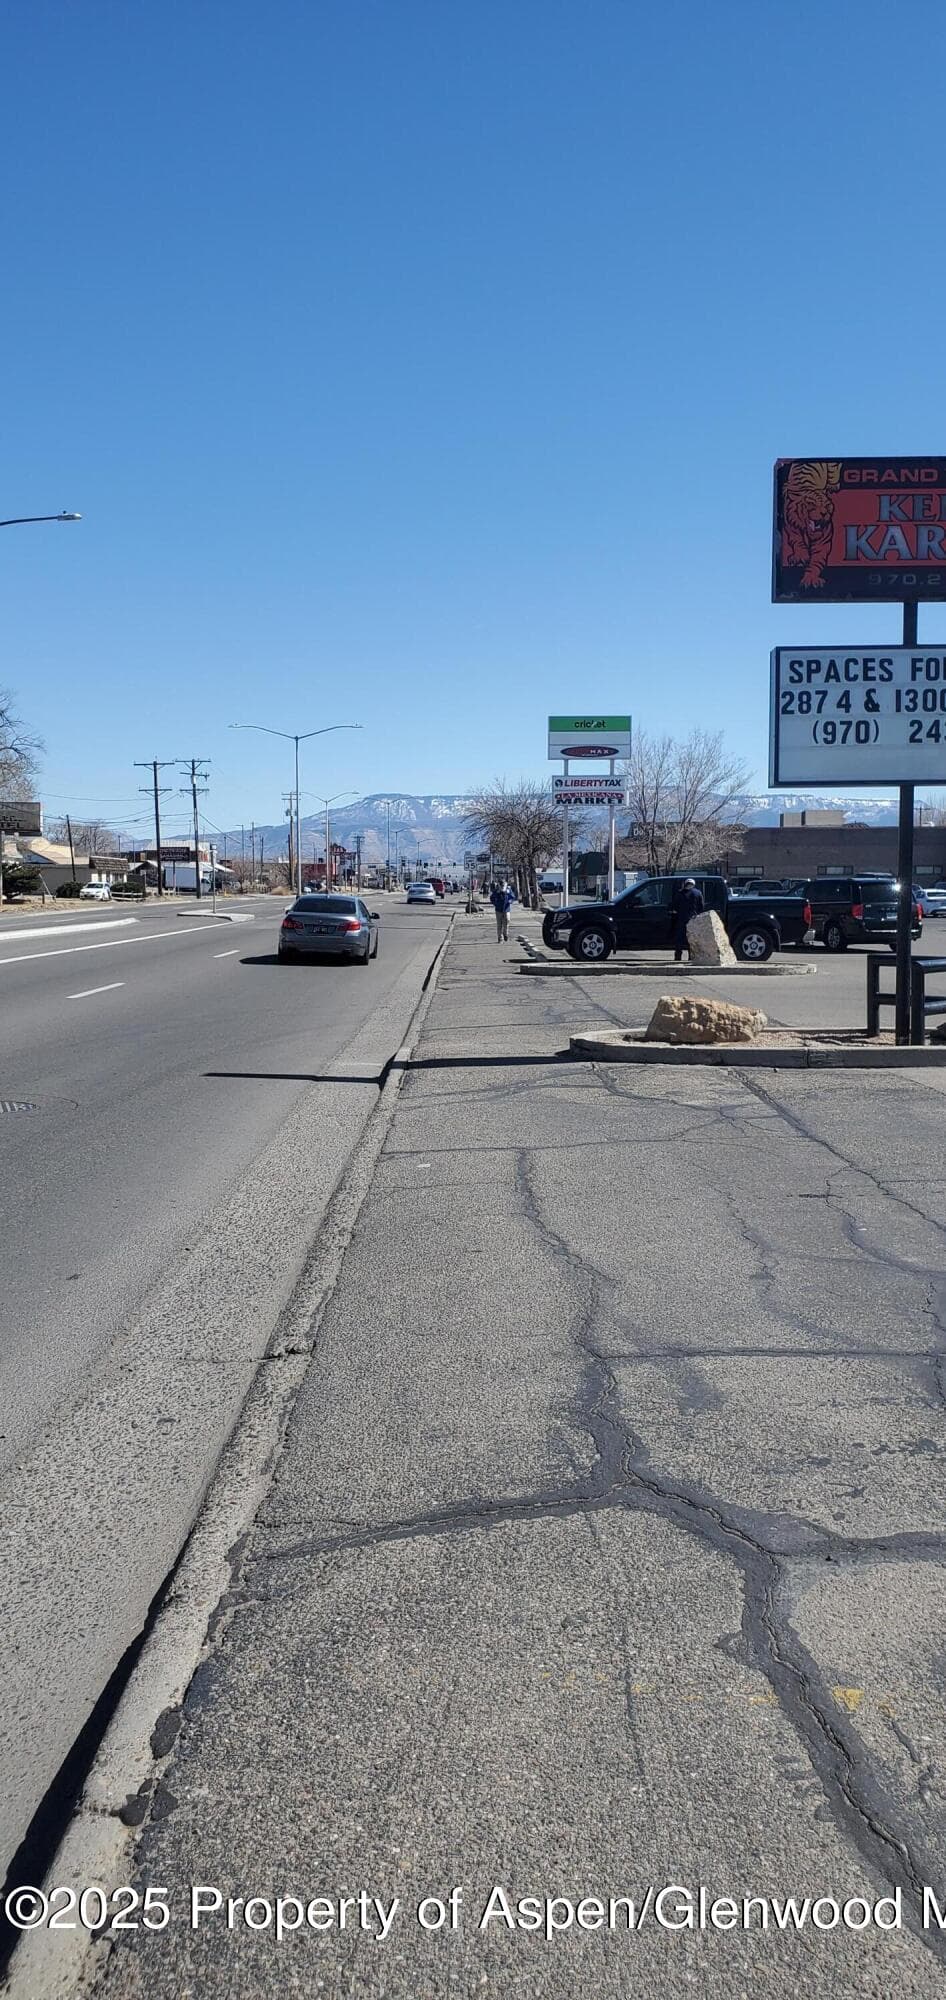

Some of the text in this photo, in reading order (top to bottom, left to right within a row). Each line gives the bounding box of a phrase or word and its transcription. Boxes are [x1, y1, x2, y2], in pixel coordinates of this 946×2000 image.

[844, 468, 938, 483] GRAND
[869, 573, 941, 585] 970.2
[789, 658, 893, 684] SPACES
[864, 688, 880, 713] &
[574, 719, 607, 728] cricket
[812, 719, 880, 745] (970)
